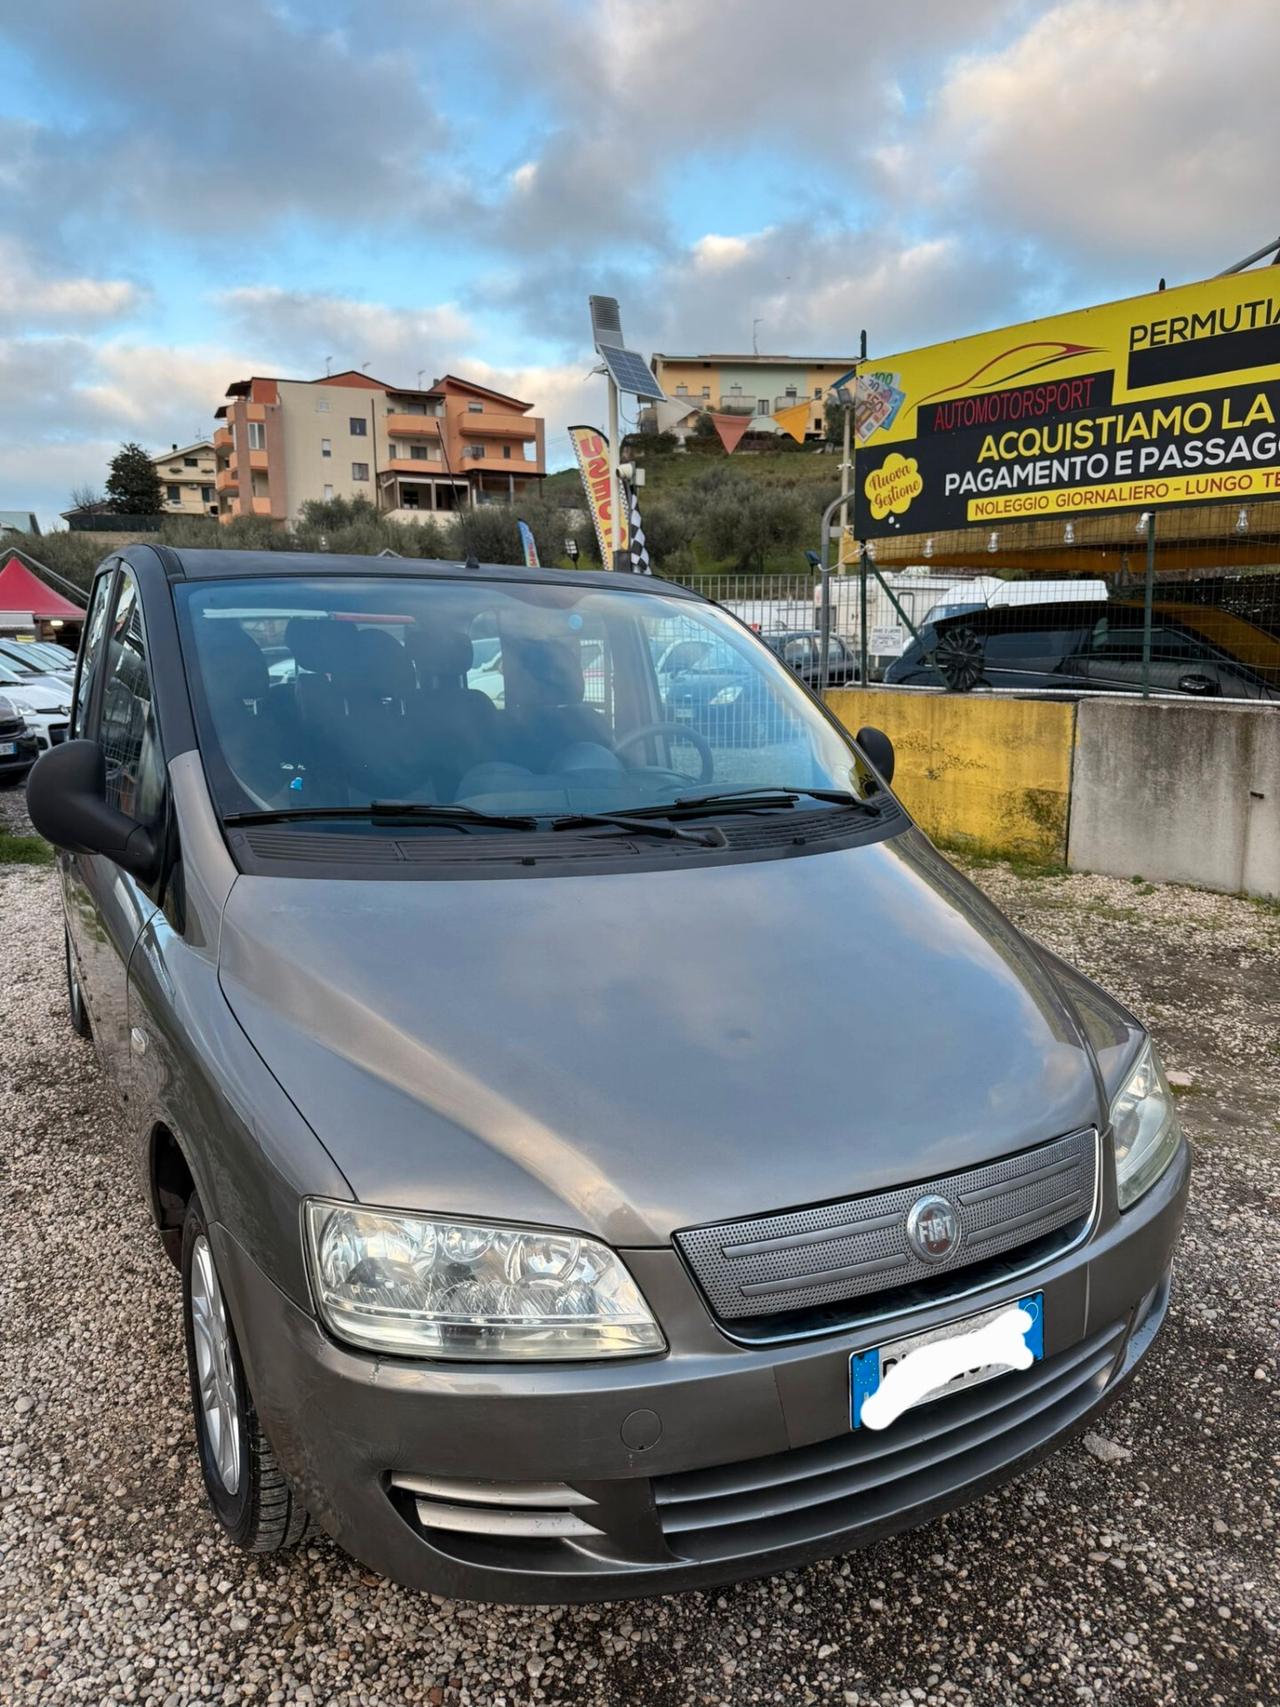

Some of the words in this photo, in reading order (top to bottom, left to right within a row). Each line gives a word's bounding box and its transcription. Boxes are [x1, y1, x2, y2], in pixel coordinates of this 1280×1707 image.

[1129, 298, 1280, 351] PERMUTI
[934, 377, 1095, 432] AUTOMOTORSPORT
[977, 402, 1212, 464] ACQUISTIAMO
[1221, 393, 1276, 430] LA
[869, 464, 912, 491] Nuova
[945, 453, 1109, 496] PAGAMENTO
[1114, 449, 1134, 476] E
[1139, 431, 1280, 474] PASSAG
[874, 479, 920, 508] Gestione
[974, 495, 1050, 516] NOLEGGIO
[1056, 483, 1169, 507] GIORNALIERO
[1185, 474, 1253, 496] LUNGO
[918, 1215, 952, 1243] FIAT
